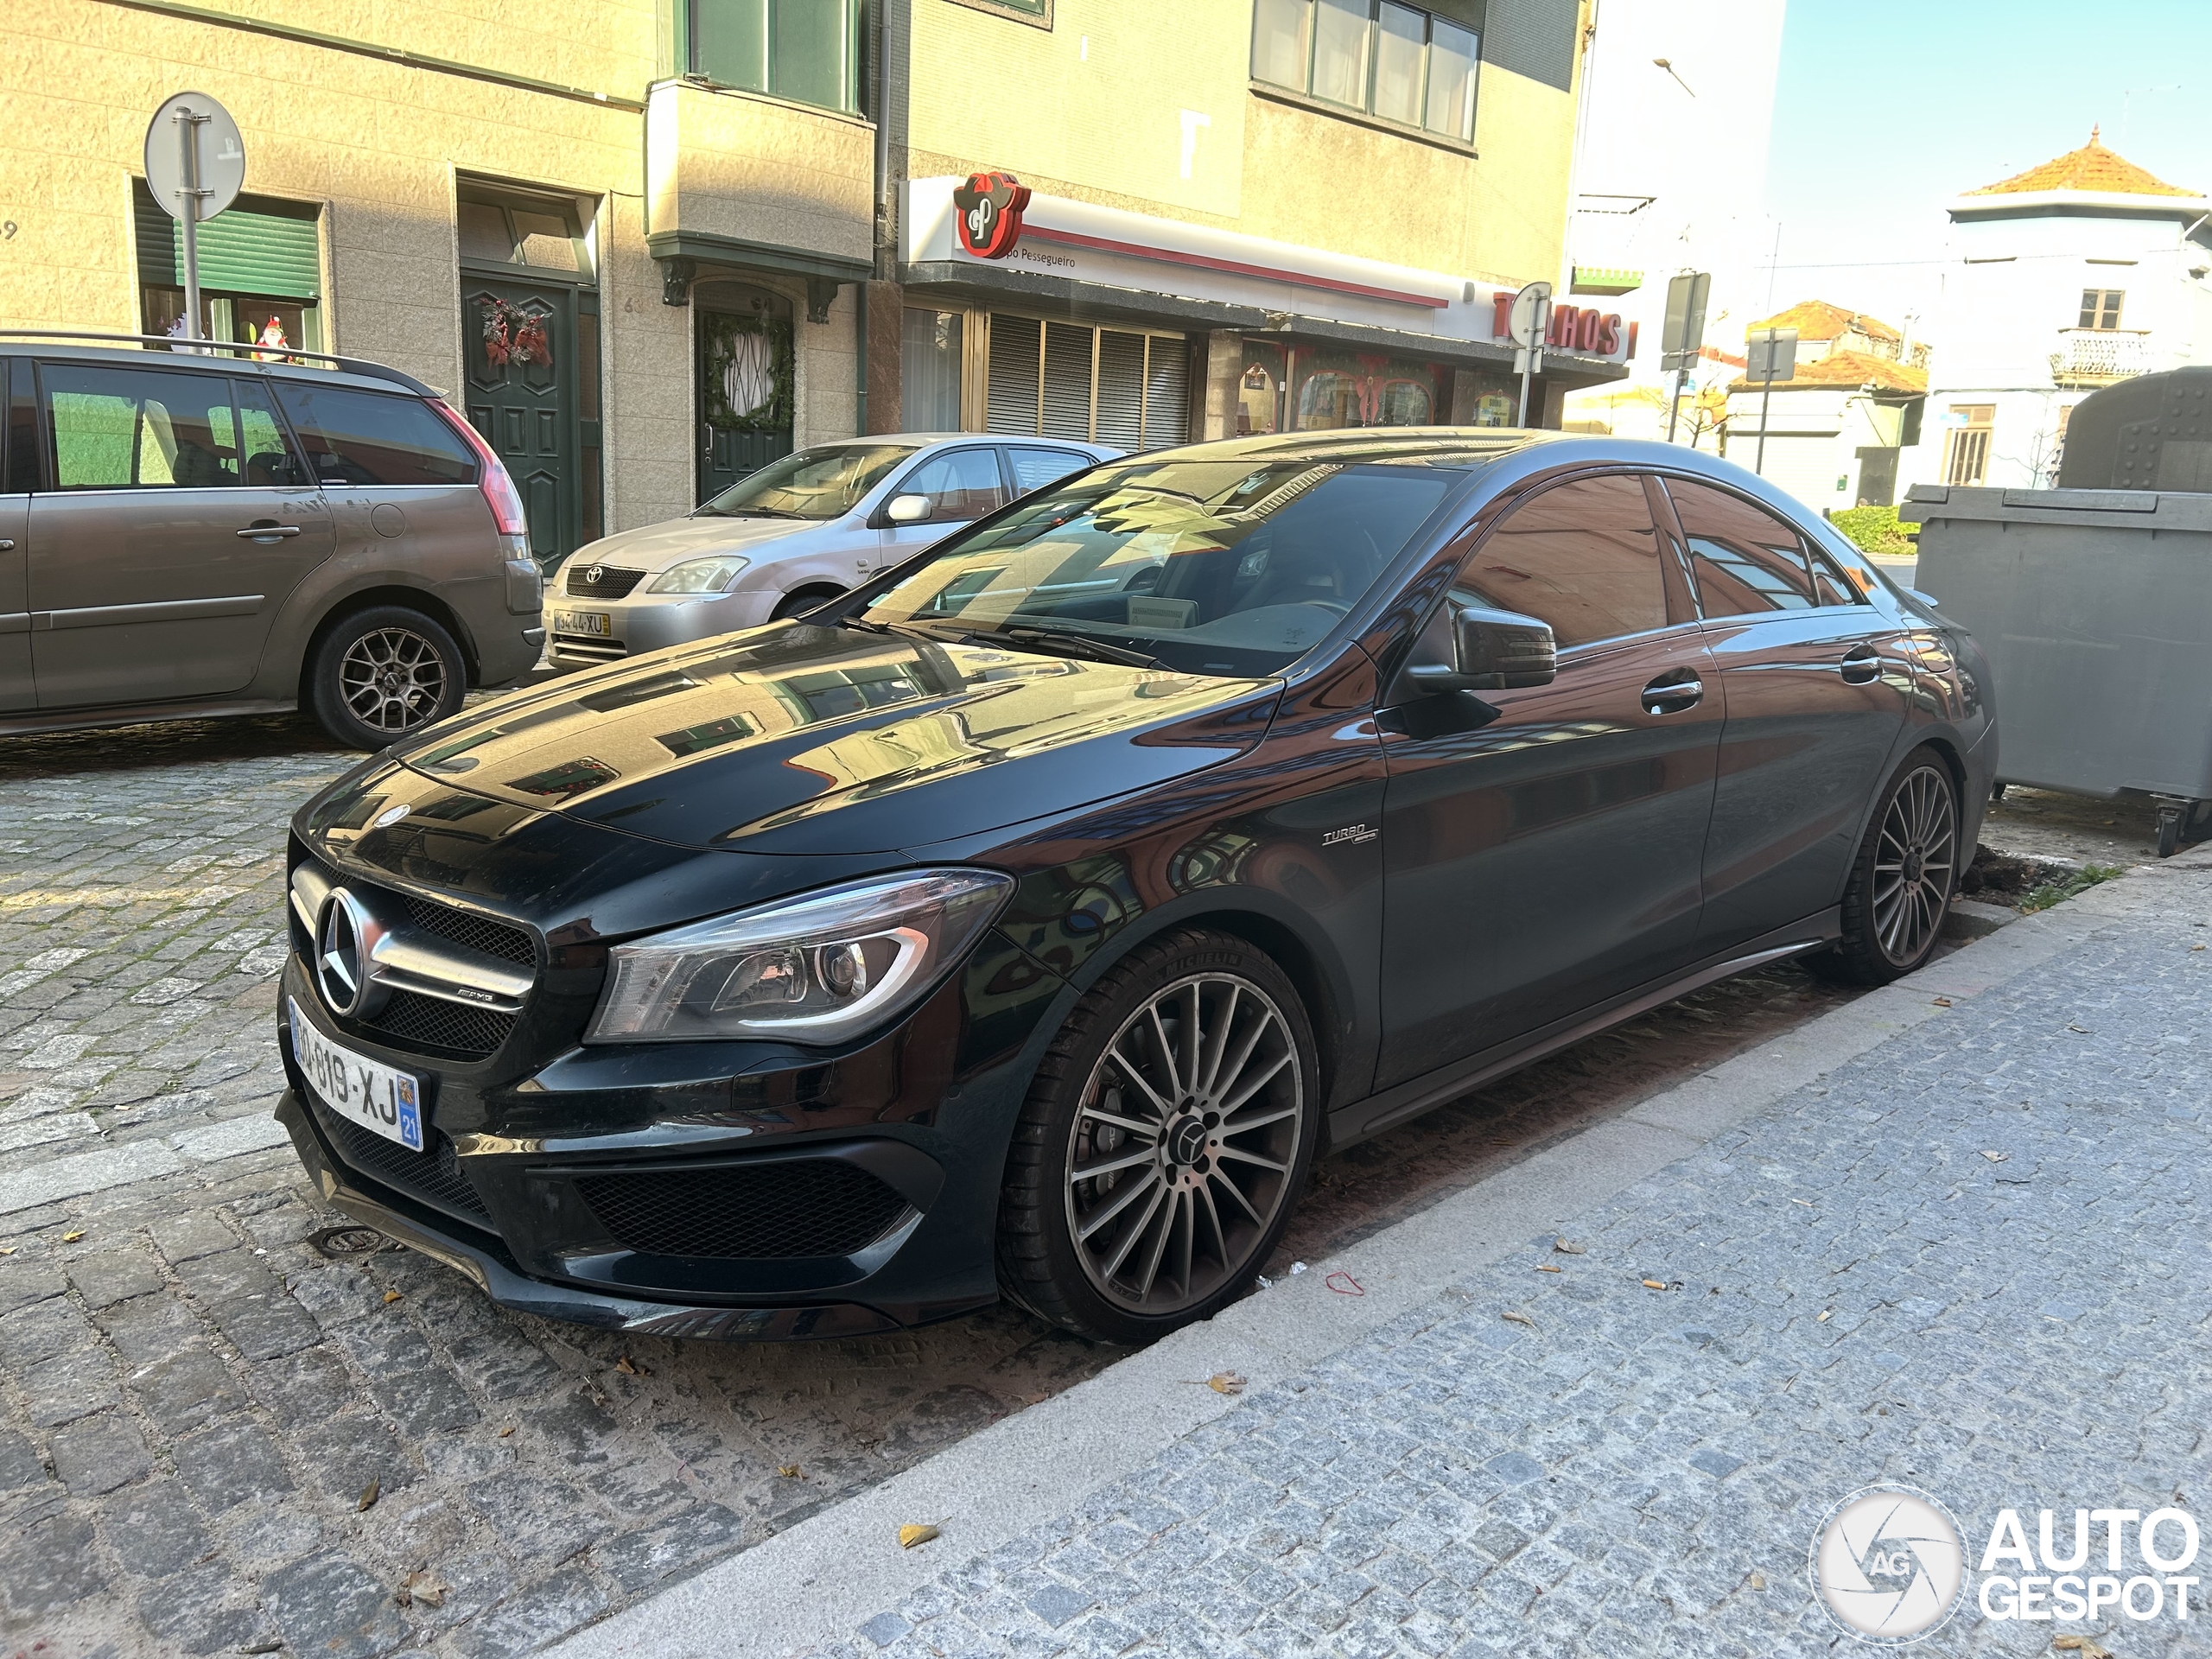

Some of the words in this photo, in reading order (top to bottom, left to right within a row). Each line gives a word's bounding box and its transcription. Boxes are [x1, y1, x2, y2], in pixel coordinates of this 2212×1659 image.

[0, 219, 18, 240] 9
[1021, 248, 1076, 267] Pessegueiro
[1493, 292, 1622, 355] TLHOS
[1323, 823, 1365, 842] TURBO
[1166, 951, 1239, 976] MICHELIN
[403, 1114, 416, 1140] 21
